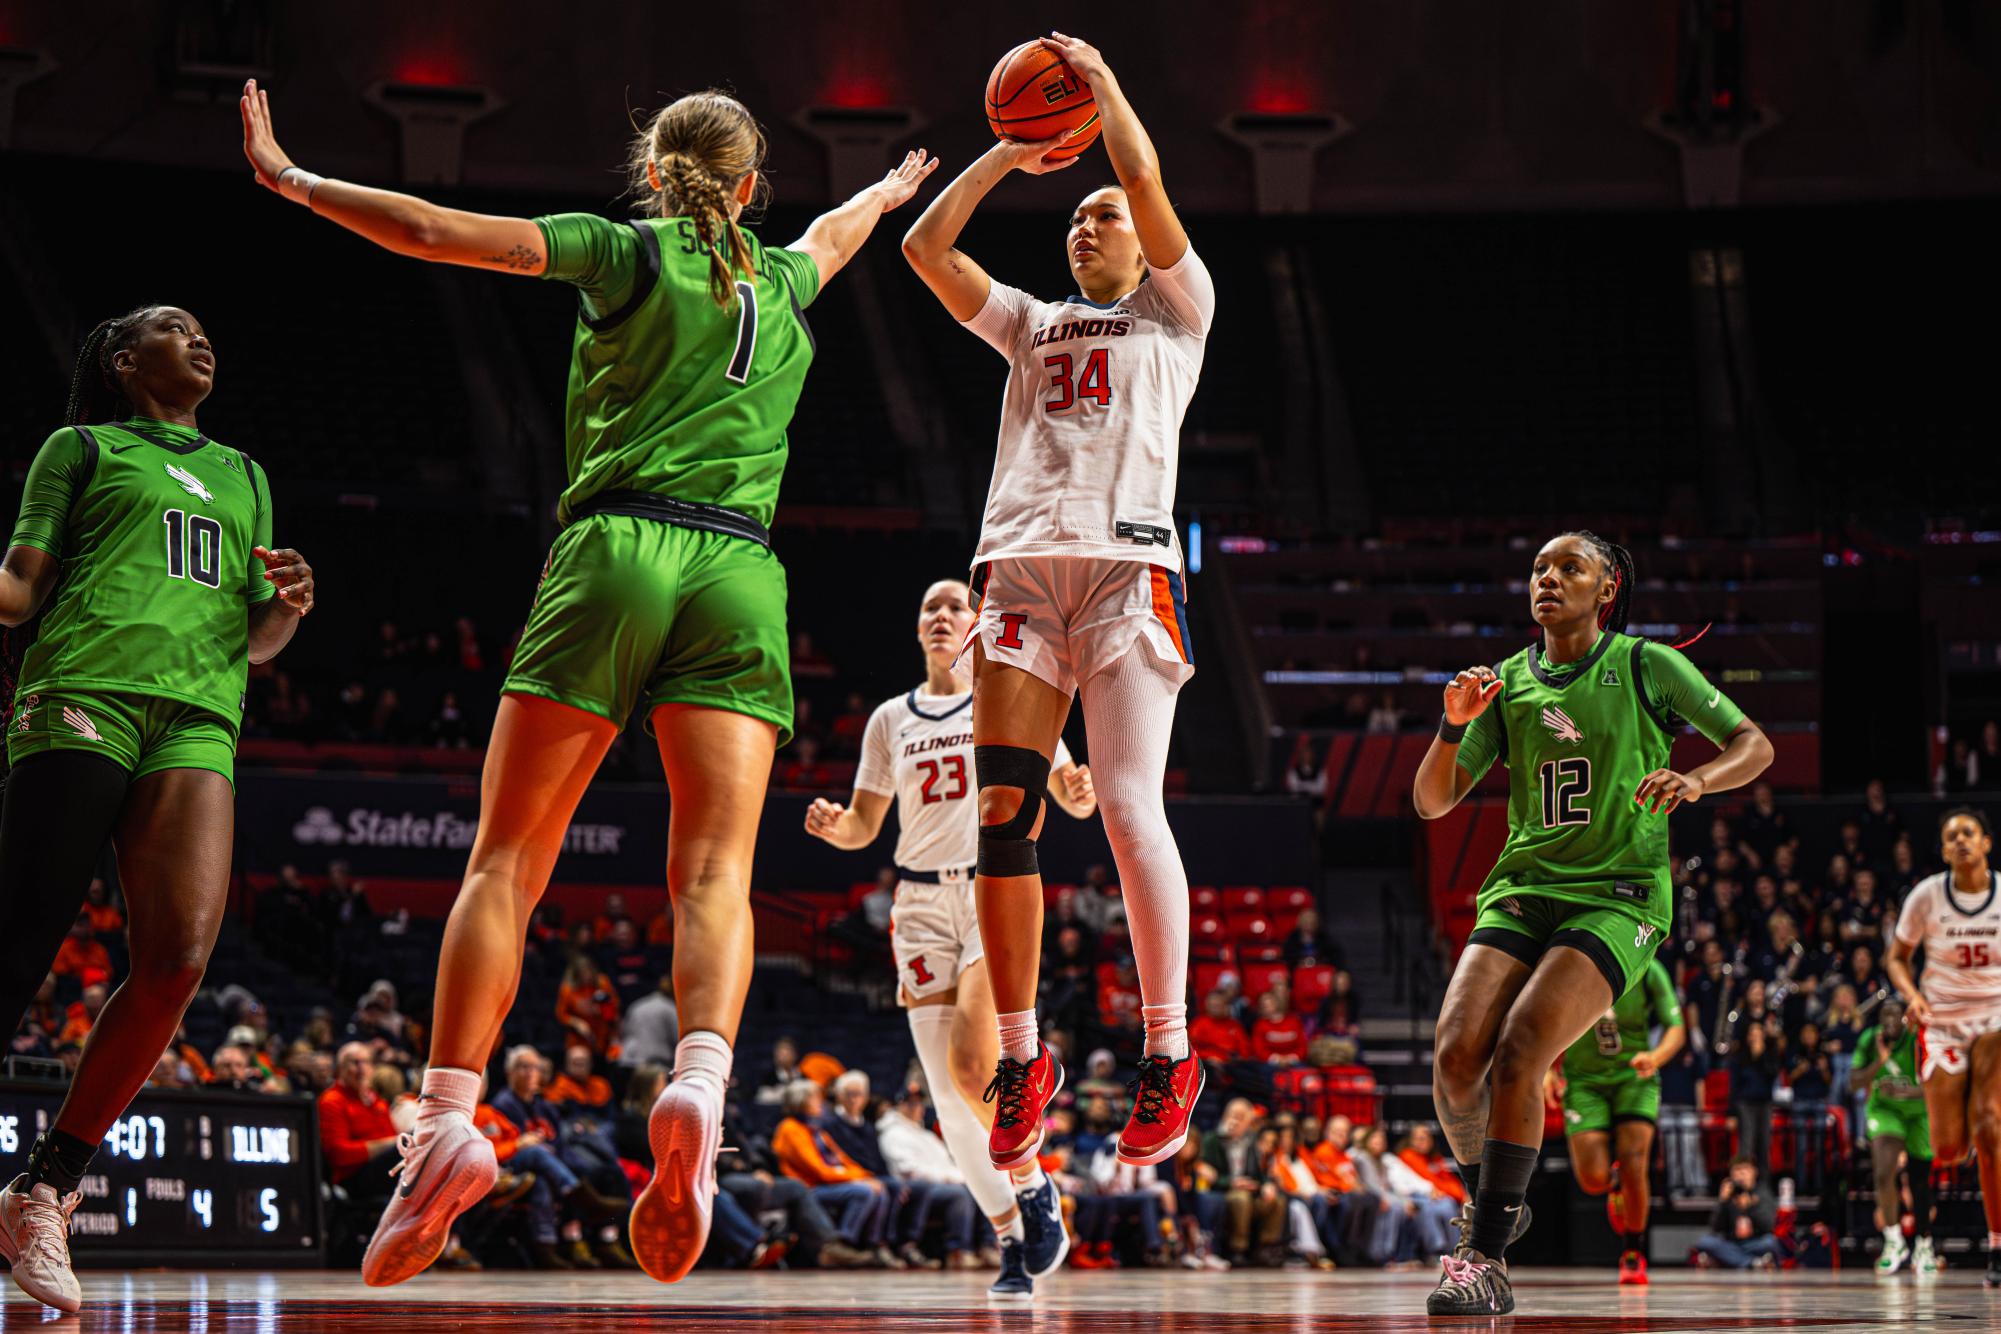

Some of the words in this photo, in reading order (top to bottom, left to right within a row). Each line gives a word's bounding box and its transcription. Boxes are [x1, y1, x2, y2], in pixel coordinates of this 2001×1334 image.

[725, 280, 758, 384] 1
[1031, 320, 1131, 352] ILLINOIS
[1044, 348, 1111, 413] 34
[163, 508, 222, 590] 10
[916, 754, 968, 806] 23
[1539, 756, 1592, 829] 12
[1955, 943, 1990, 969] 35
[103, 1115, 165, 1160] 4:07
[127, 1187, 137, 1228] 1
[146, 1177, 186, 1202] FOULS
[193, 1188, 213, 1229] 4
[259, 1187, 280, 1233] 5
[72, 1212, 118, 1236] PERIOD
